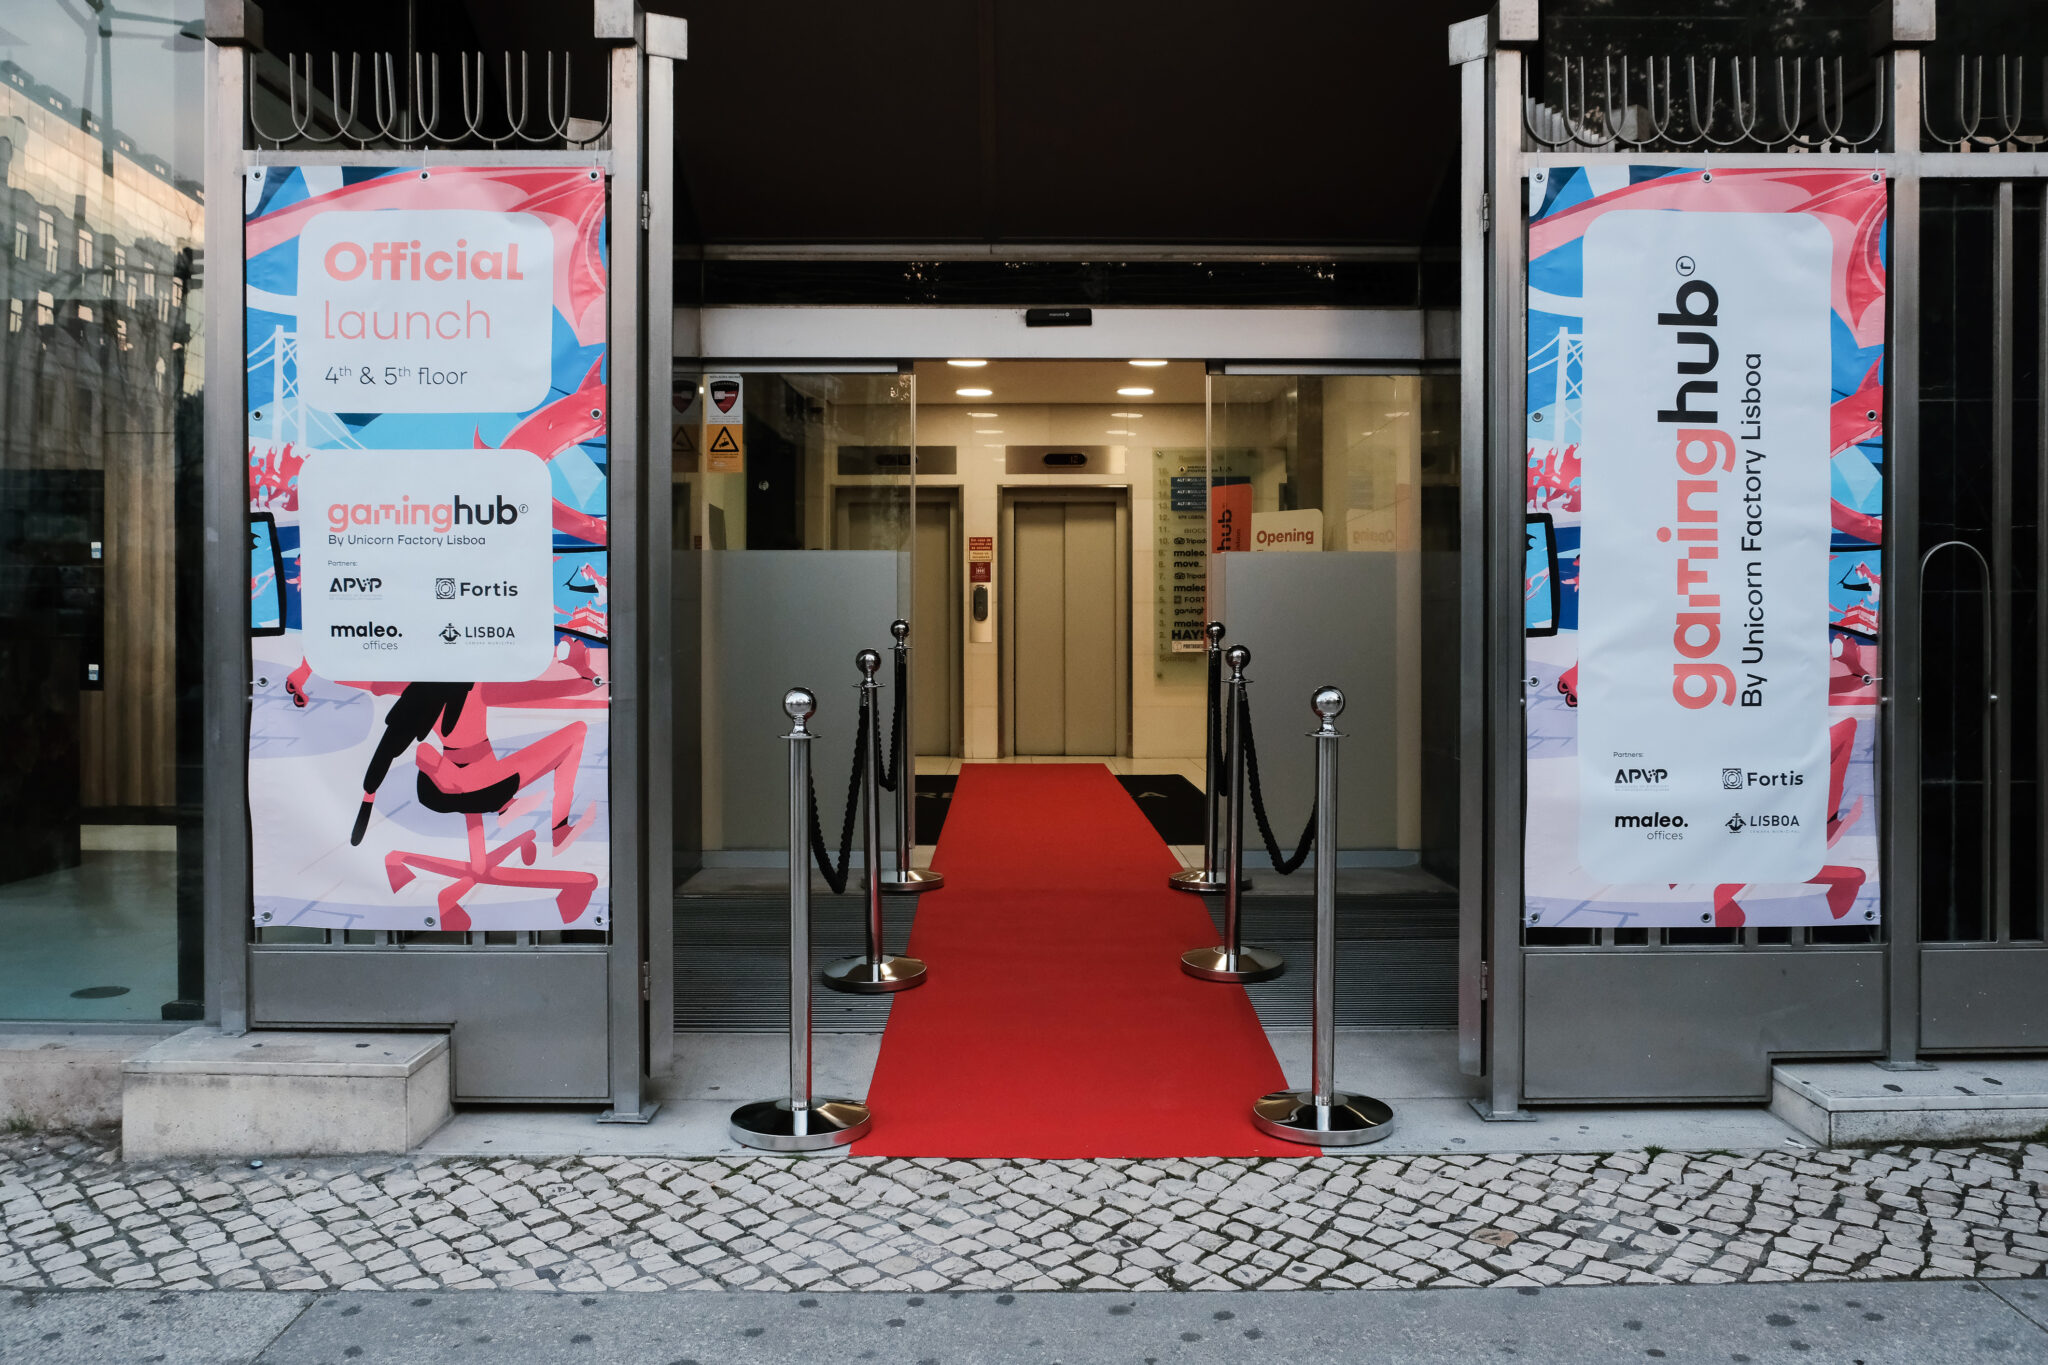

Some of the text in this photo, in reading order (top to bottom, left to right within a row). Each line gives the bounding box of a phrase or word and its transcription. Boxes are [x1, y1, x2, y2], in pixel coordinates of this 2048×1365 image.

[323, 239, 525, 281] Official
[323, 300, 492, 340] launch
[324, 366, 469, 385] 4th & 5th floor
[1257, 528, 1314, 546] Opening
[1740, 353, 1767, 708] By Unicorn Factory Lisboa
[328, 534, 486, 547] By Unicorn Factory Lisboa
[329, 577, 383, 593] APVP
[460, 580, 519, 597] Fortis
[330, 621, 403, 638] maleo.
[465, 626, 516, 638] LISBOA
[362, 640, 399, 651] offices
[1614, 768, 1669, 784] APVP
[1747, 770, 1804, 786] Fortis
[1614, 811, 1689, 828] maleo.
[1749, 815, 1800, 827] LISBOA
[1646, 830, 1684, 840] offices
